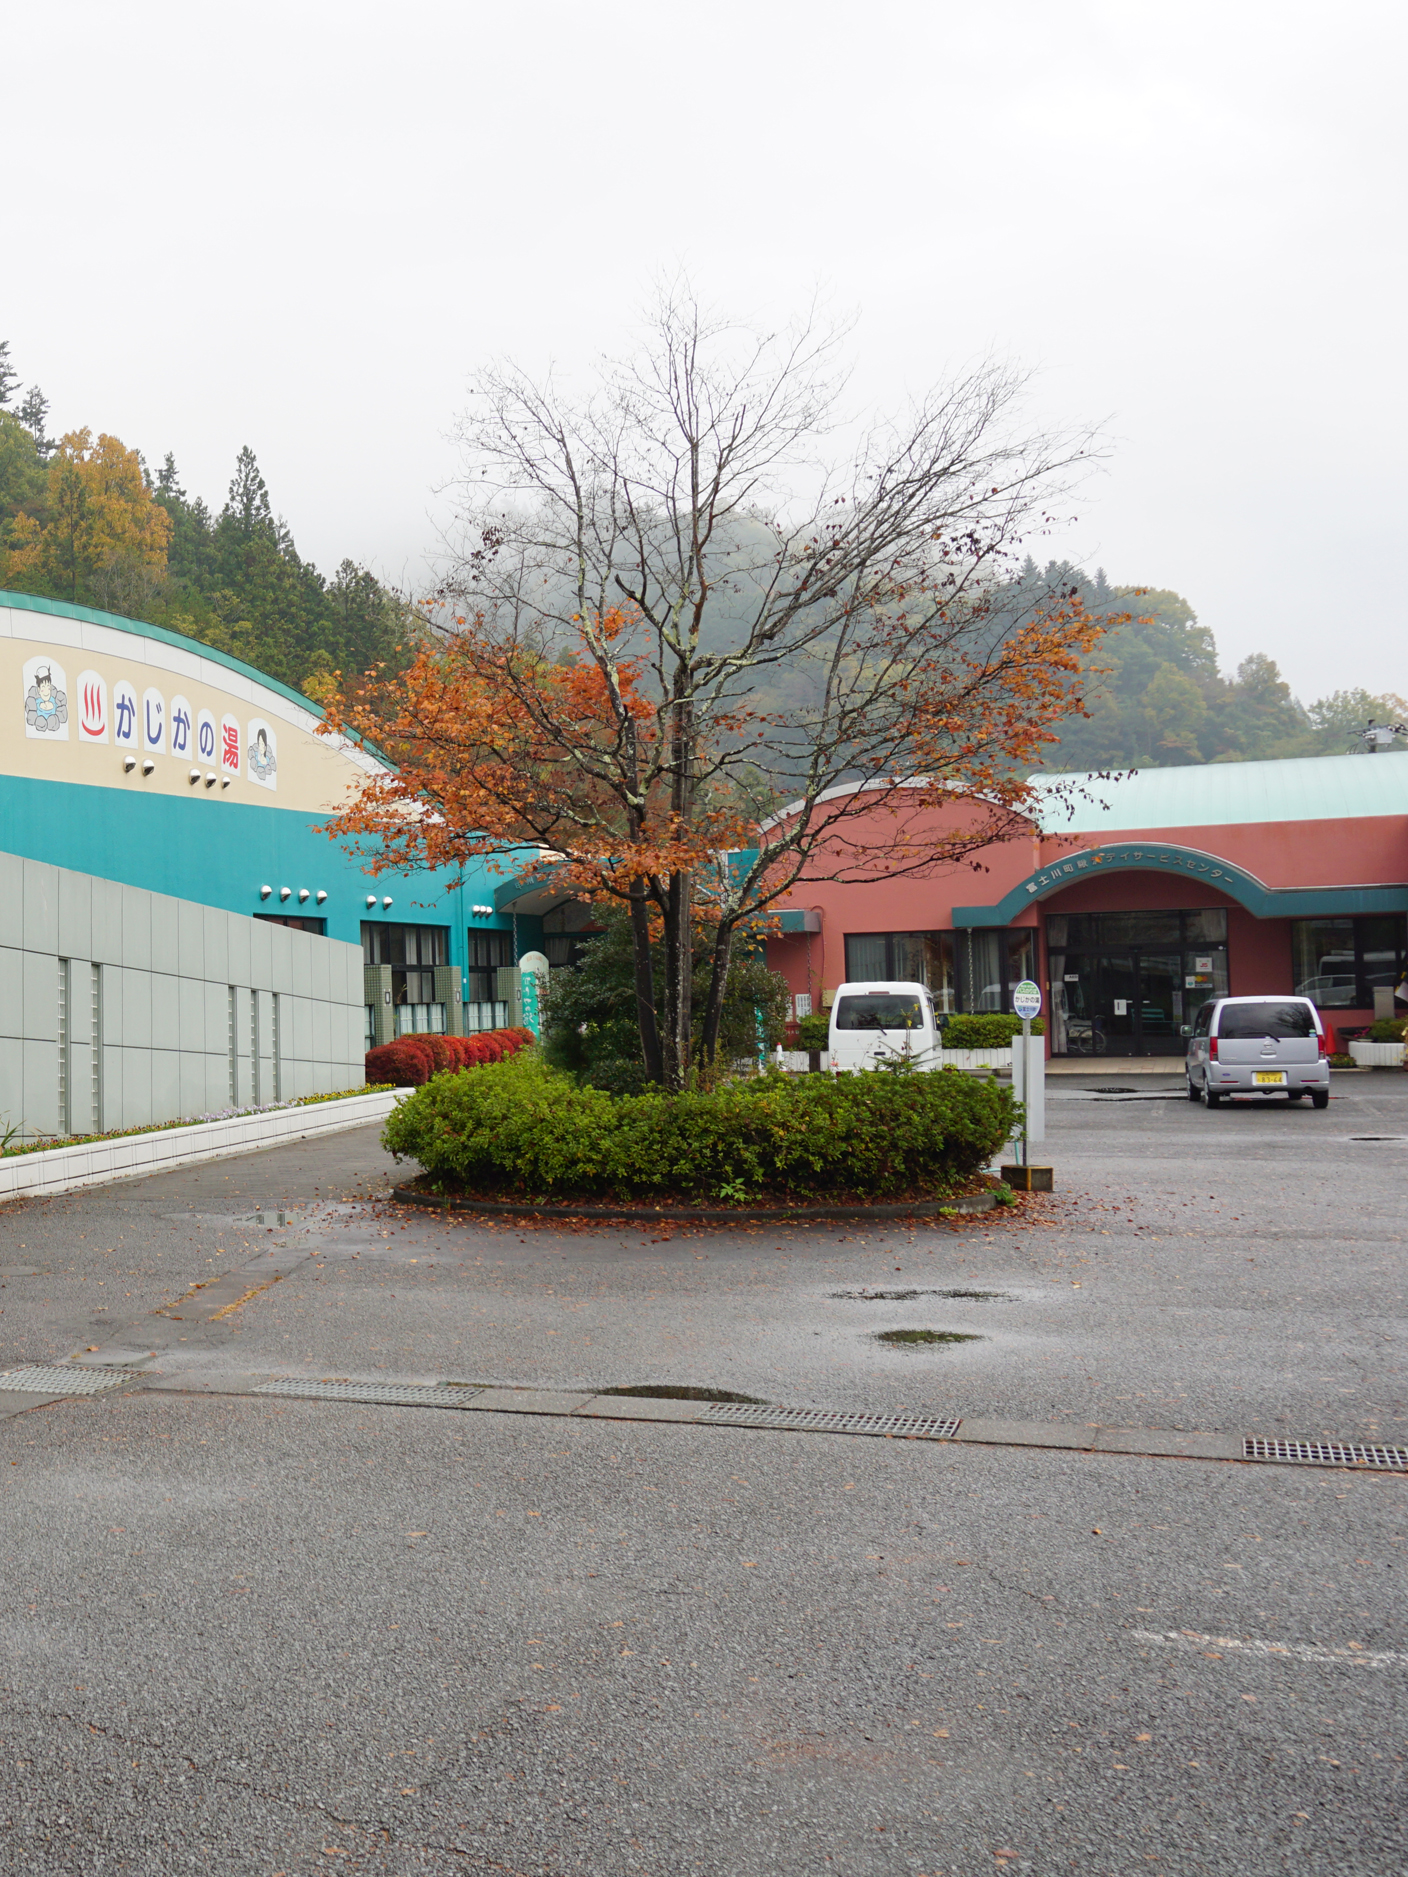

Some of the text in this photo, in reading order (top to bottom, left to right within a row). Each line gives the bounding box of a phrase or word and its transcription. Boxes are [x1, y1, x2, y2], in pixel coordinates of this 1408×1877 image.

[116, 693, 240, 769] かじかの湯
[1015, 996, 1040, 1004] かじかの湯
